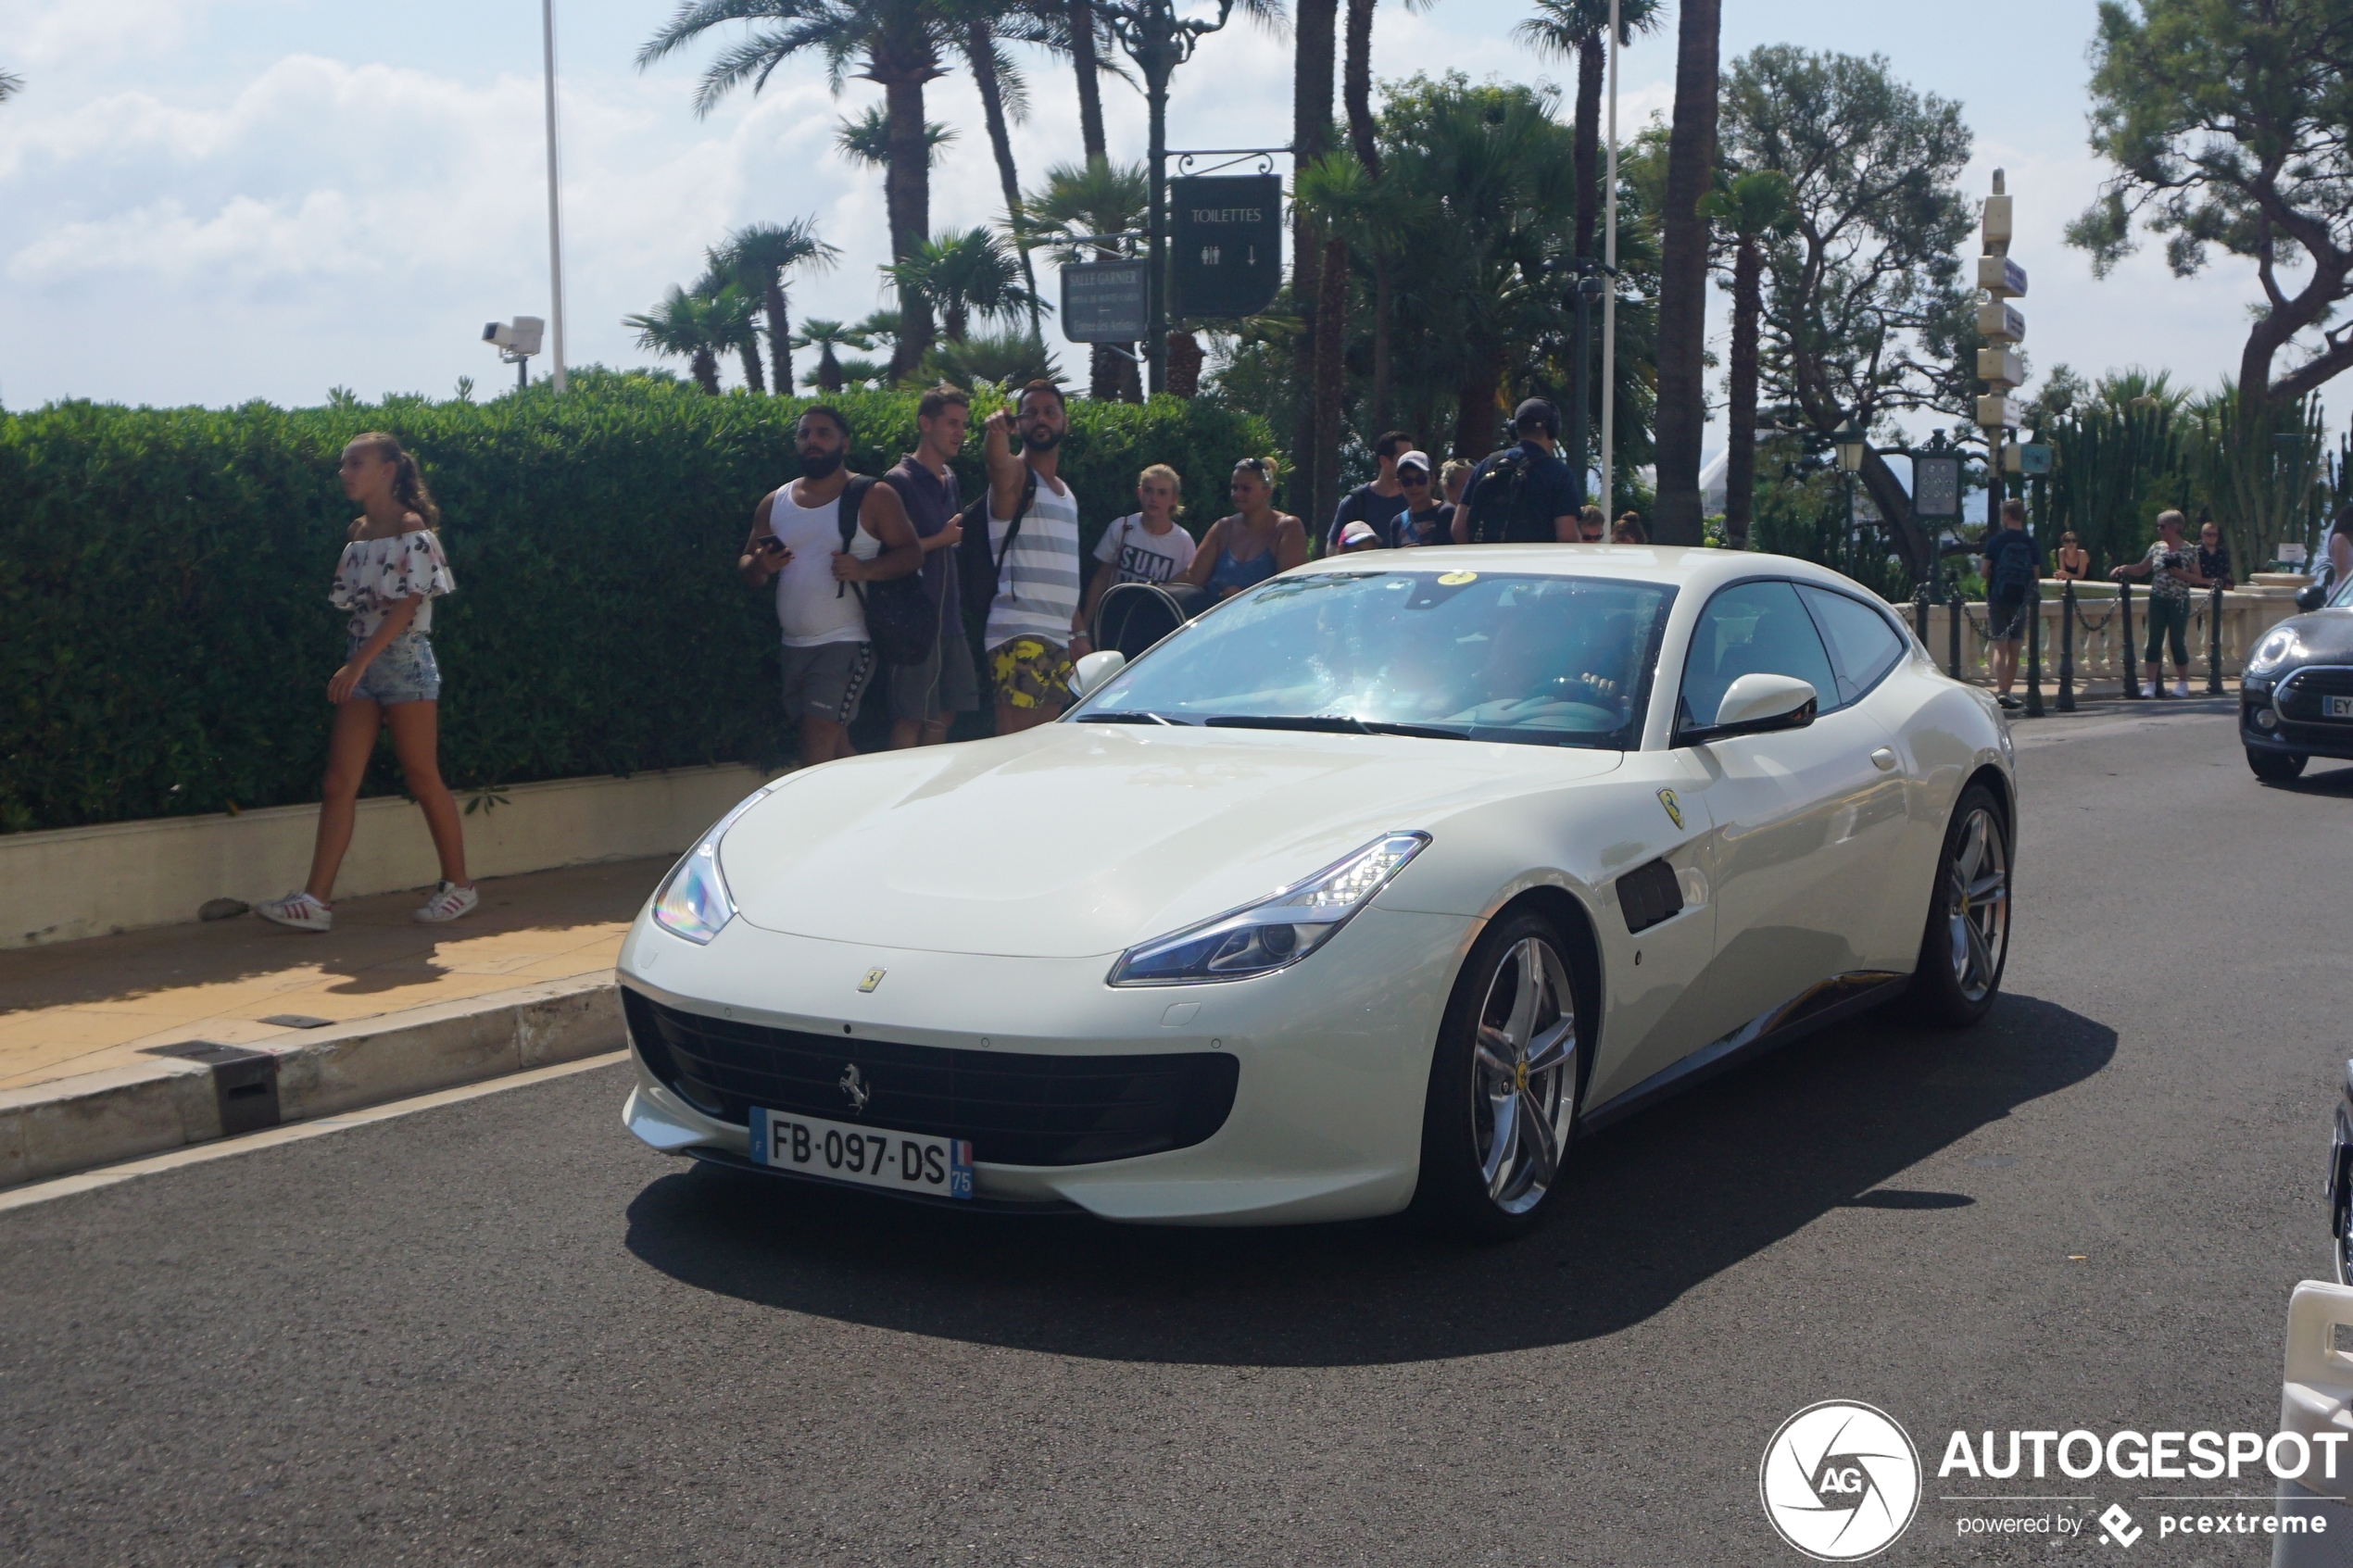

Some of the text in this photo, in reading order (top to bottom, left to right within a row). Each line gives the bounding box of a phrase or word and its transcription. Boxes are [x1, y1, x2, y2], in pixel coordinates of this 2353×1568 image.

[1191, 208, 1262, 223] TOILETTES
[1120, 546, 1171, 581] SUM
[755, 1140, 761, 1152] F
[773, 1120, 945, 1185] FB-097-DS
[951, 1170, 971, 1192] 75
